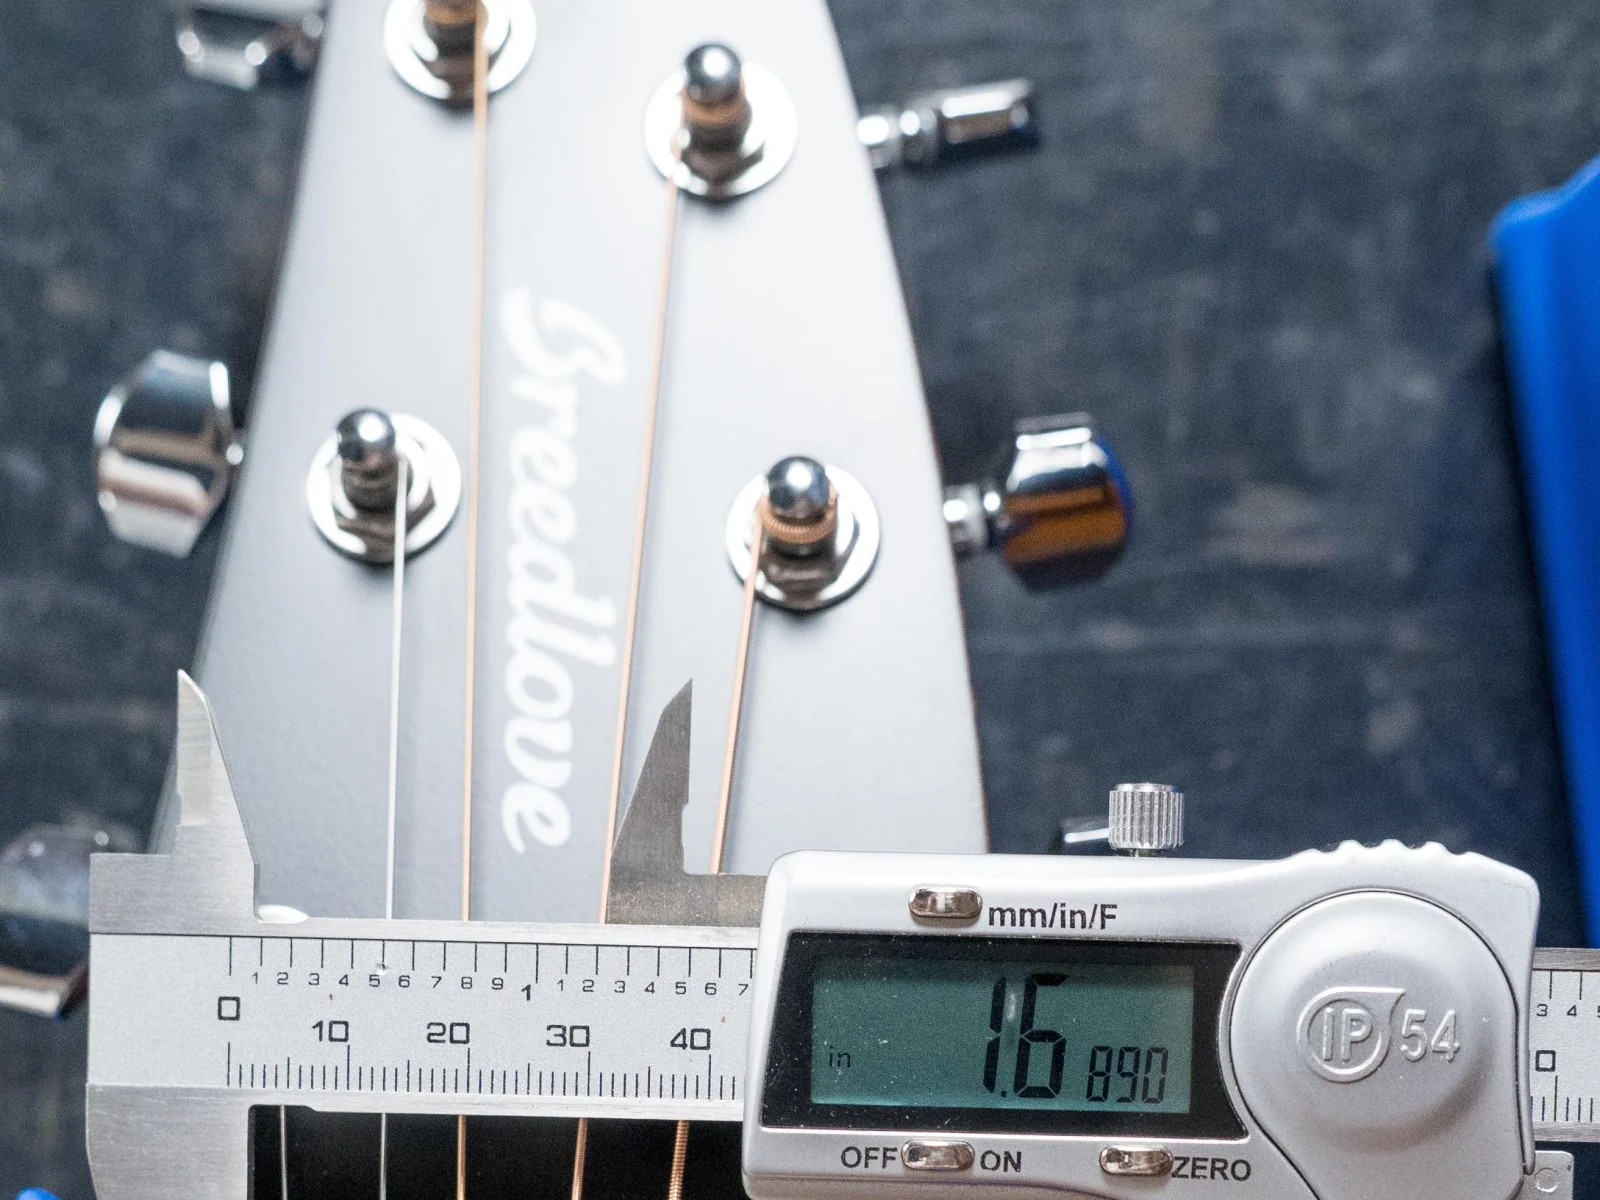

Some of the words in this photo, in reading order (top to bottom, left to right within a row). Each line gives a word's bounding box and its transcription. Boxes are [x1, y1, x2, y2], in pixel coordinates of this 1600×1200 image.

[500, 287, 626, 855] Breedlove
[987, 902, 1118, 931] mm/in/F
[251, 972, 259, 984] 1
[276, 972, 289, 985] 2
[308, 973, 320, 986] 3
[338, 974, 349, 986] 4
[368, 975, 381, 988] 5
[398, 975, 411, 988] 6
[431, 976, 442, 989] 7
[460, 977, 473, 990] 8
[491, 977, 504, 990] 9
[521, 984, 532, 1001] 1
[556, 979, 564, 991] 1
[582, 979, 595, 992] 2
[613, 980, 626, 993] 3
[644, 981, 655, 994] 4
[675, 982, 687, 995] 5
[704, 982, 717, 995] 6
[737, 983, 749, 996] 7
[217, 996, 241, 1021] 0
[311, 1020, 349, 1042] 10
[426, 1022, 470, 1044] 20
[545, 1024, 590, 1048] 30
[669, 1027, 711, 1050] 40
[1536, 1003, 1548, 1017] 3
[1566, 1004, 1577, 1018] 4
[1321, 1007, 1374, 1062] IP
[1400, 1008, 1461, 1063] 54
[828, 1045, 852, 1068] in
[840, 1145, 898, 1170] OFF
[979, 1149, 1022, 1173] ON
[1171, 1155, 1252, 1182] ZERO
